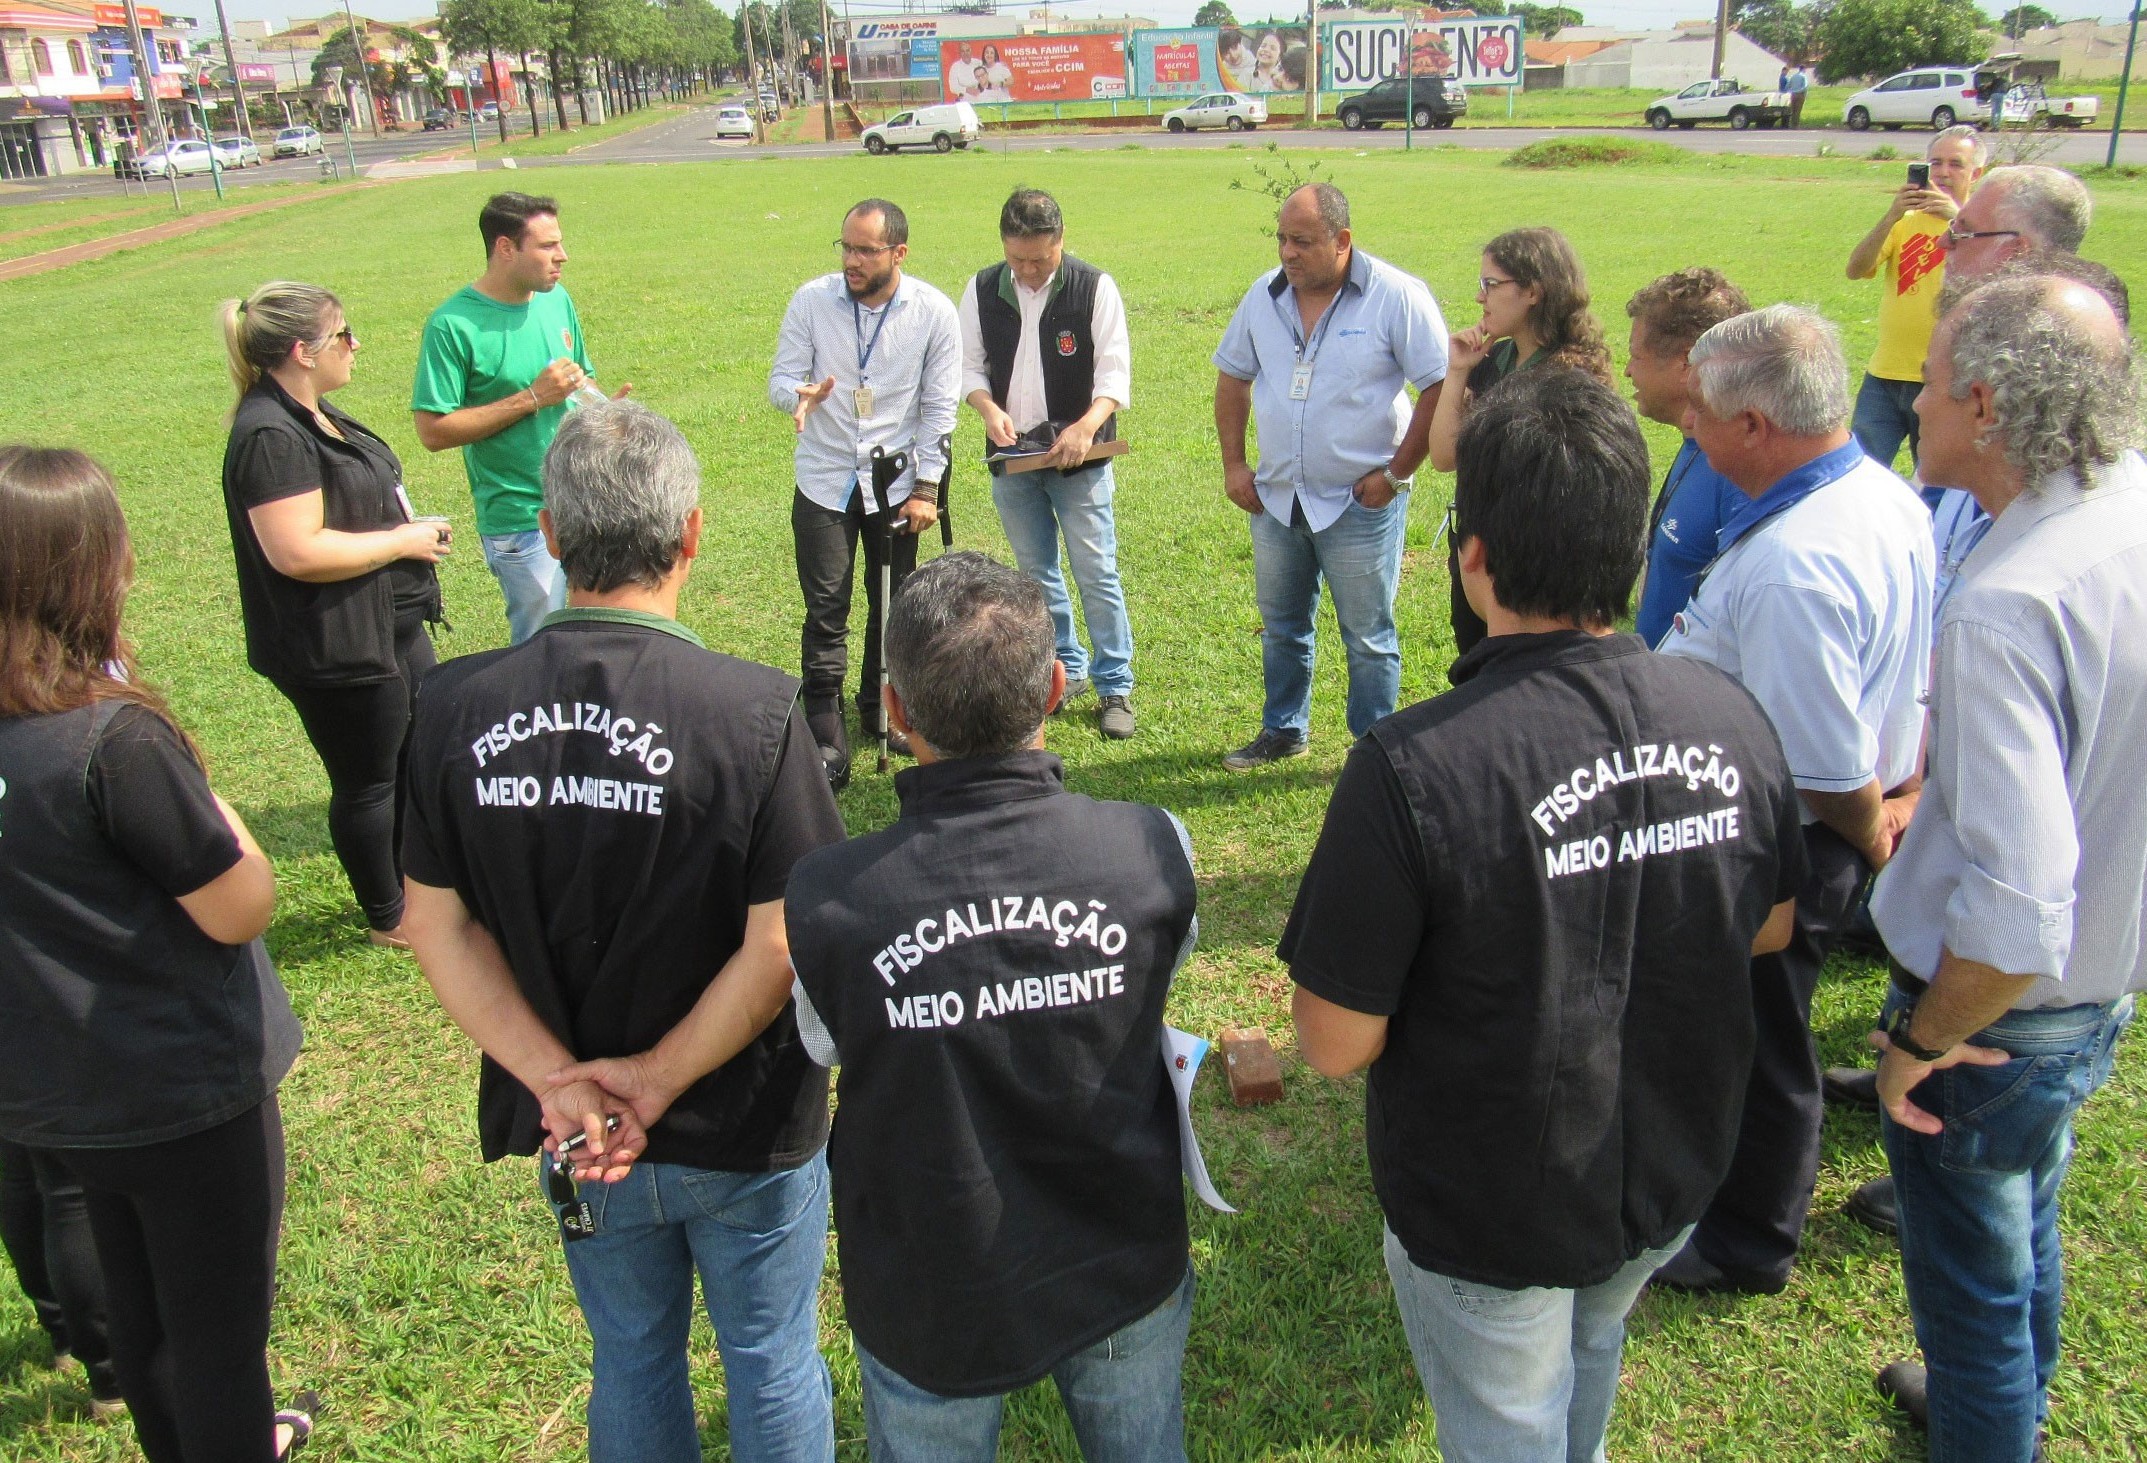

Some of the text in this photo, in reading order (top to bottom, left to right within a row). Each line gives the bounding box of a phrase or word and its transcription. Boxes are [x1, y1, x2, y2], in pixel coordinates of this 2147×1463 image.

[857, 24, 937, 38] Unidos
[1185, 31, 1213, 40] Infantil
[1004, 44, 1079, 56] NOSSA FAMÍLIA
[1156, 51, 1196, 60] MATRÍCULAS
[1055, 62, 1084, 73] CCIM
[1163, 62, 1190, 70] ABERTAS
[472, 702, 674, 776] FISCALIZAÇÃO
[476, 775, 664, 816] MEIO AMBIENTE
[1530, 743, 1740, 837] FISCALIZAÇÃO
[1544, 806, 1740, 879] MEIO AMBIENTE
[872, 896, 1127, 987] FISCALIZAÇÃO
[885, 964, 1125, 1028] MEIO AMBIENTE
